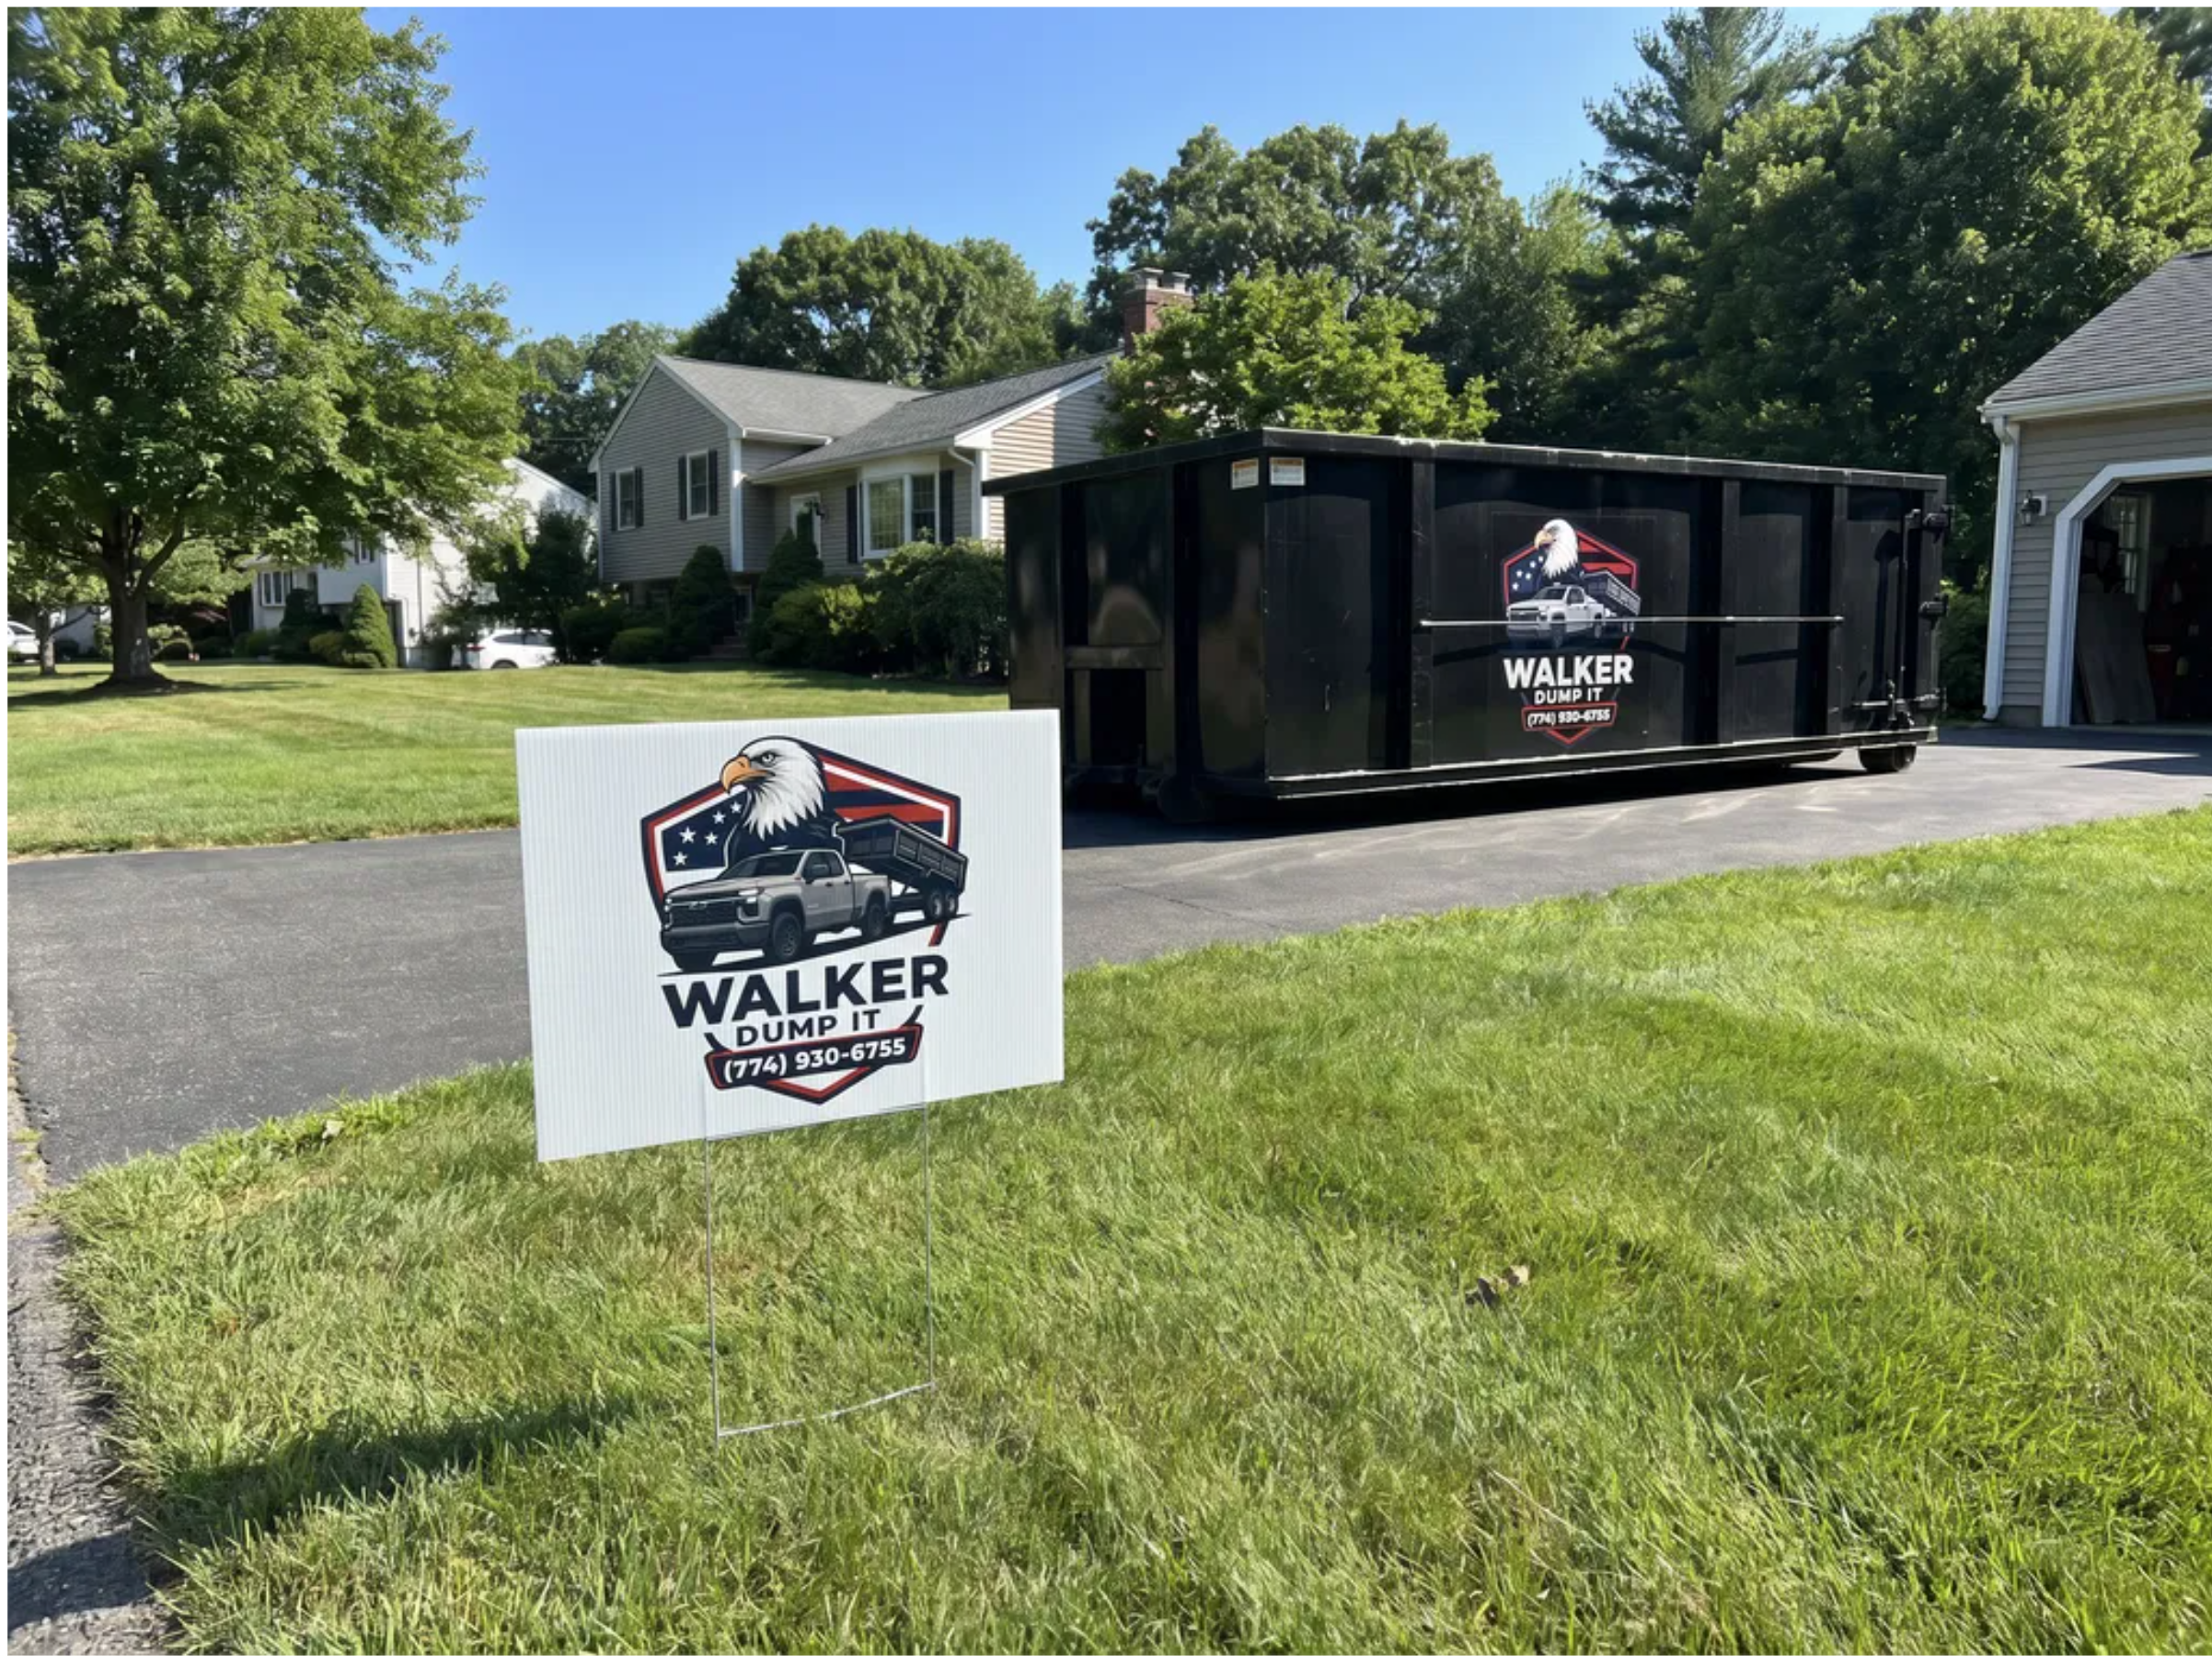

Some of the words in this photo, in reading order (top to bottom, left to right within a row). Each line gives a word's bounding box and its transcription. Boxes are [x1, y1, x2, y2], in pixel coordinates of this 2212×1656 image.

[1503, 655, 1633, 688] WALKER
[1535, 689, 1582, 704] DUMP
[1587, 687, 1603, 701] IT
[1527, 712, 1555, 727] (774)
[1558, 708, 1610, 723] 930-6755
[662, 954, 949, 1029] WALKER
[736, 1015, 837, 1047] DUMP
[852, 1008, 881, 1031] IT
[723, 1054, 788, 1084] (774)
[794, 1037, 906, 1071] 930-6755
